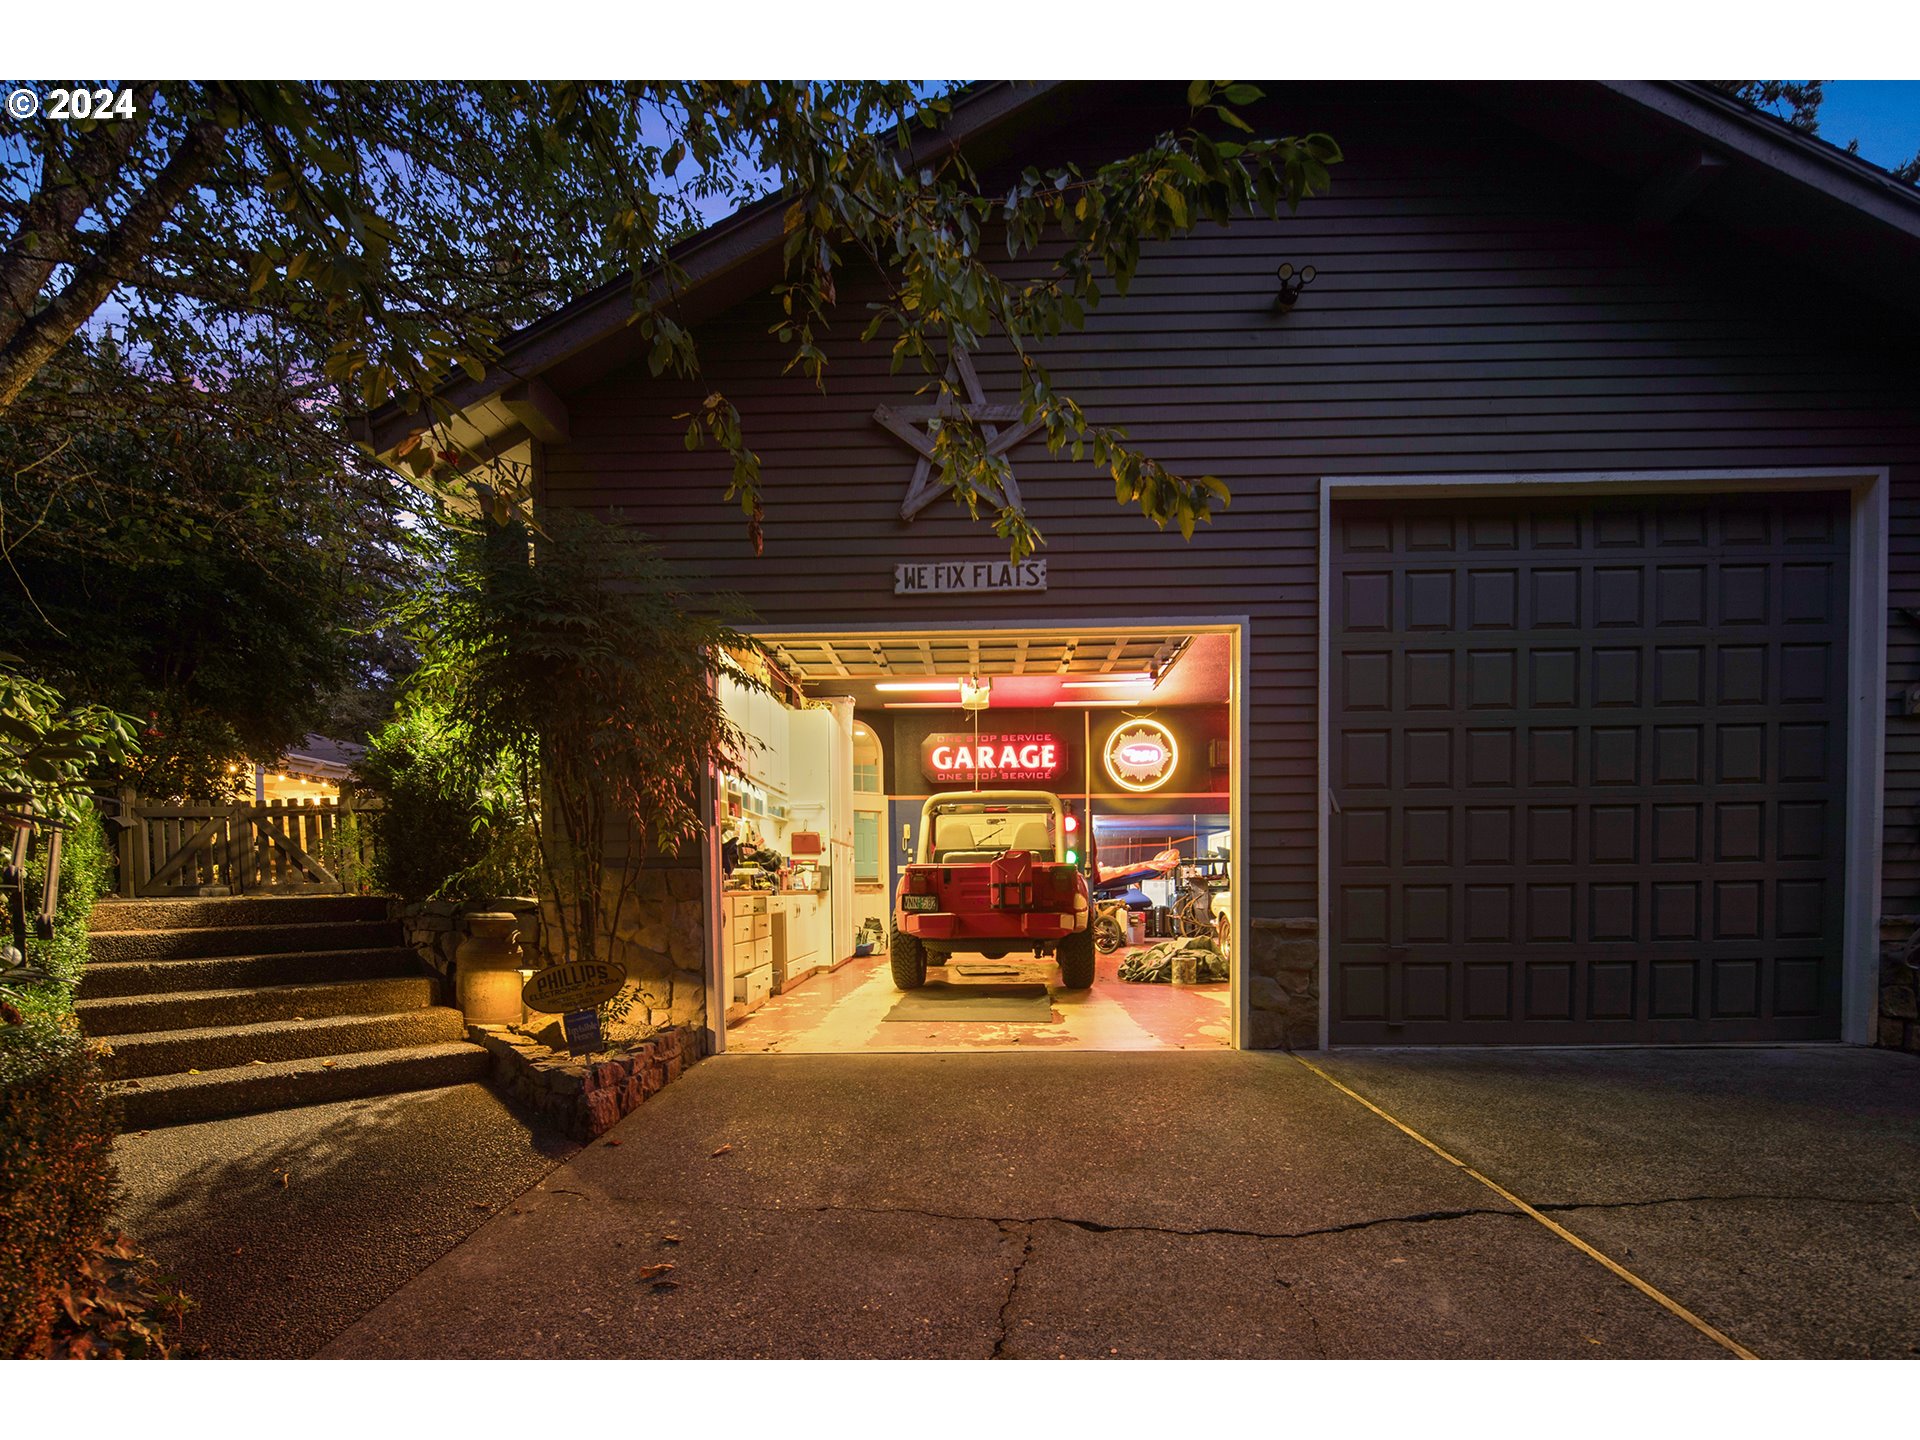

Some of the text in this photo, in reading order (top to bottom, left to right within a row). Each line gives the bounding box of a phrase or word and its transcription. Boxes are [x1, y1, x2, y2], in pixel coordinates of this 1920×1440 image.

[903, 563, 1040, 589] WE FIX FLATS
[937, 733, 1052, 743] ONE STOP SERVICE
[931, 744, 1057, 770] GARAGE
[937, 771, 1052, 781] ONE STOP SERVICE
[537, 965, 608, 992] PHILLIPS
